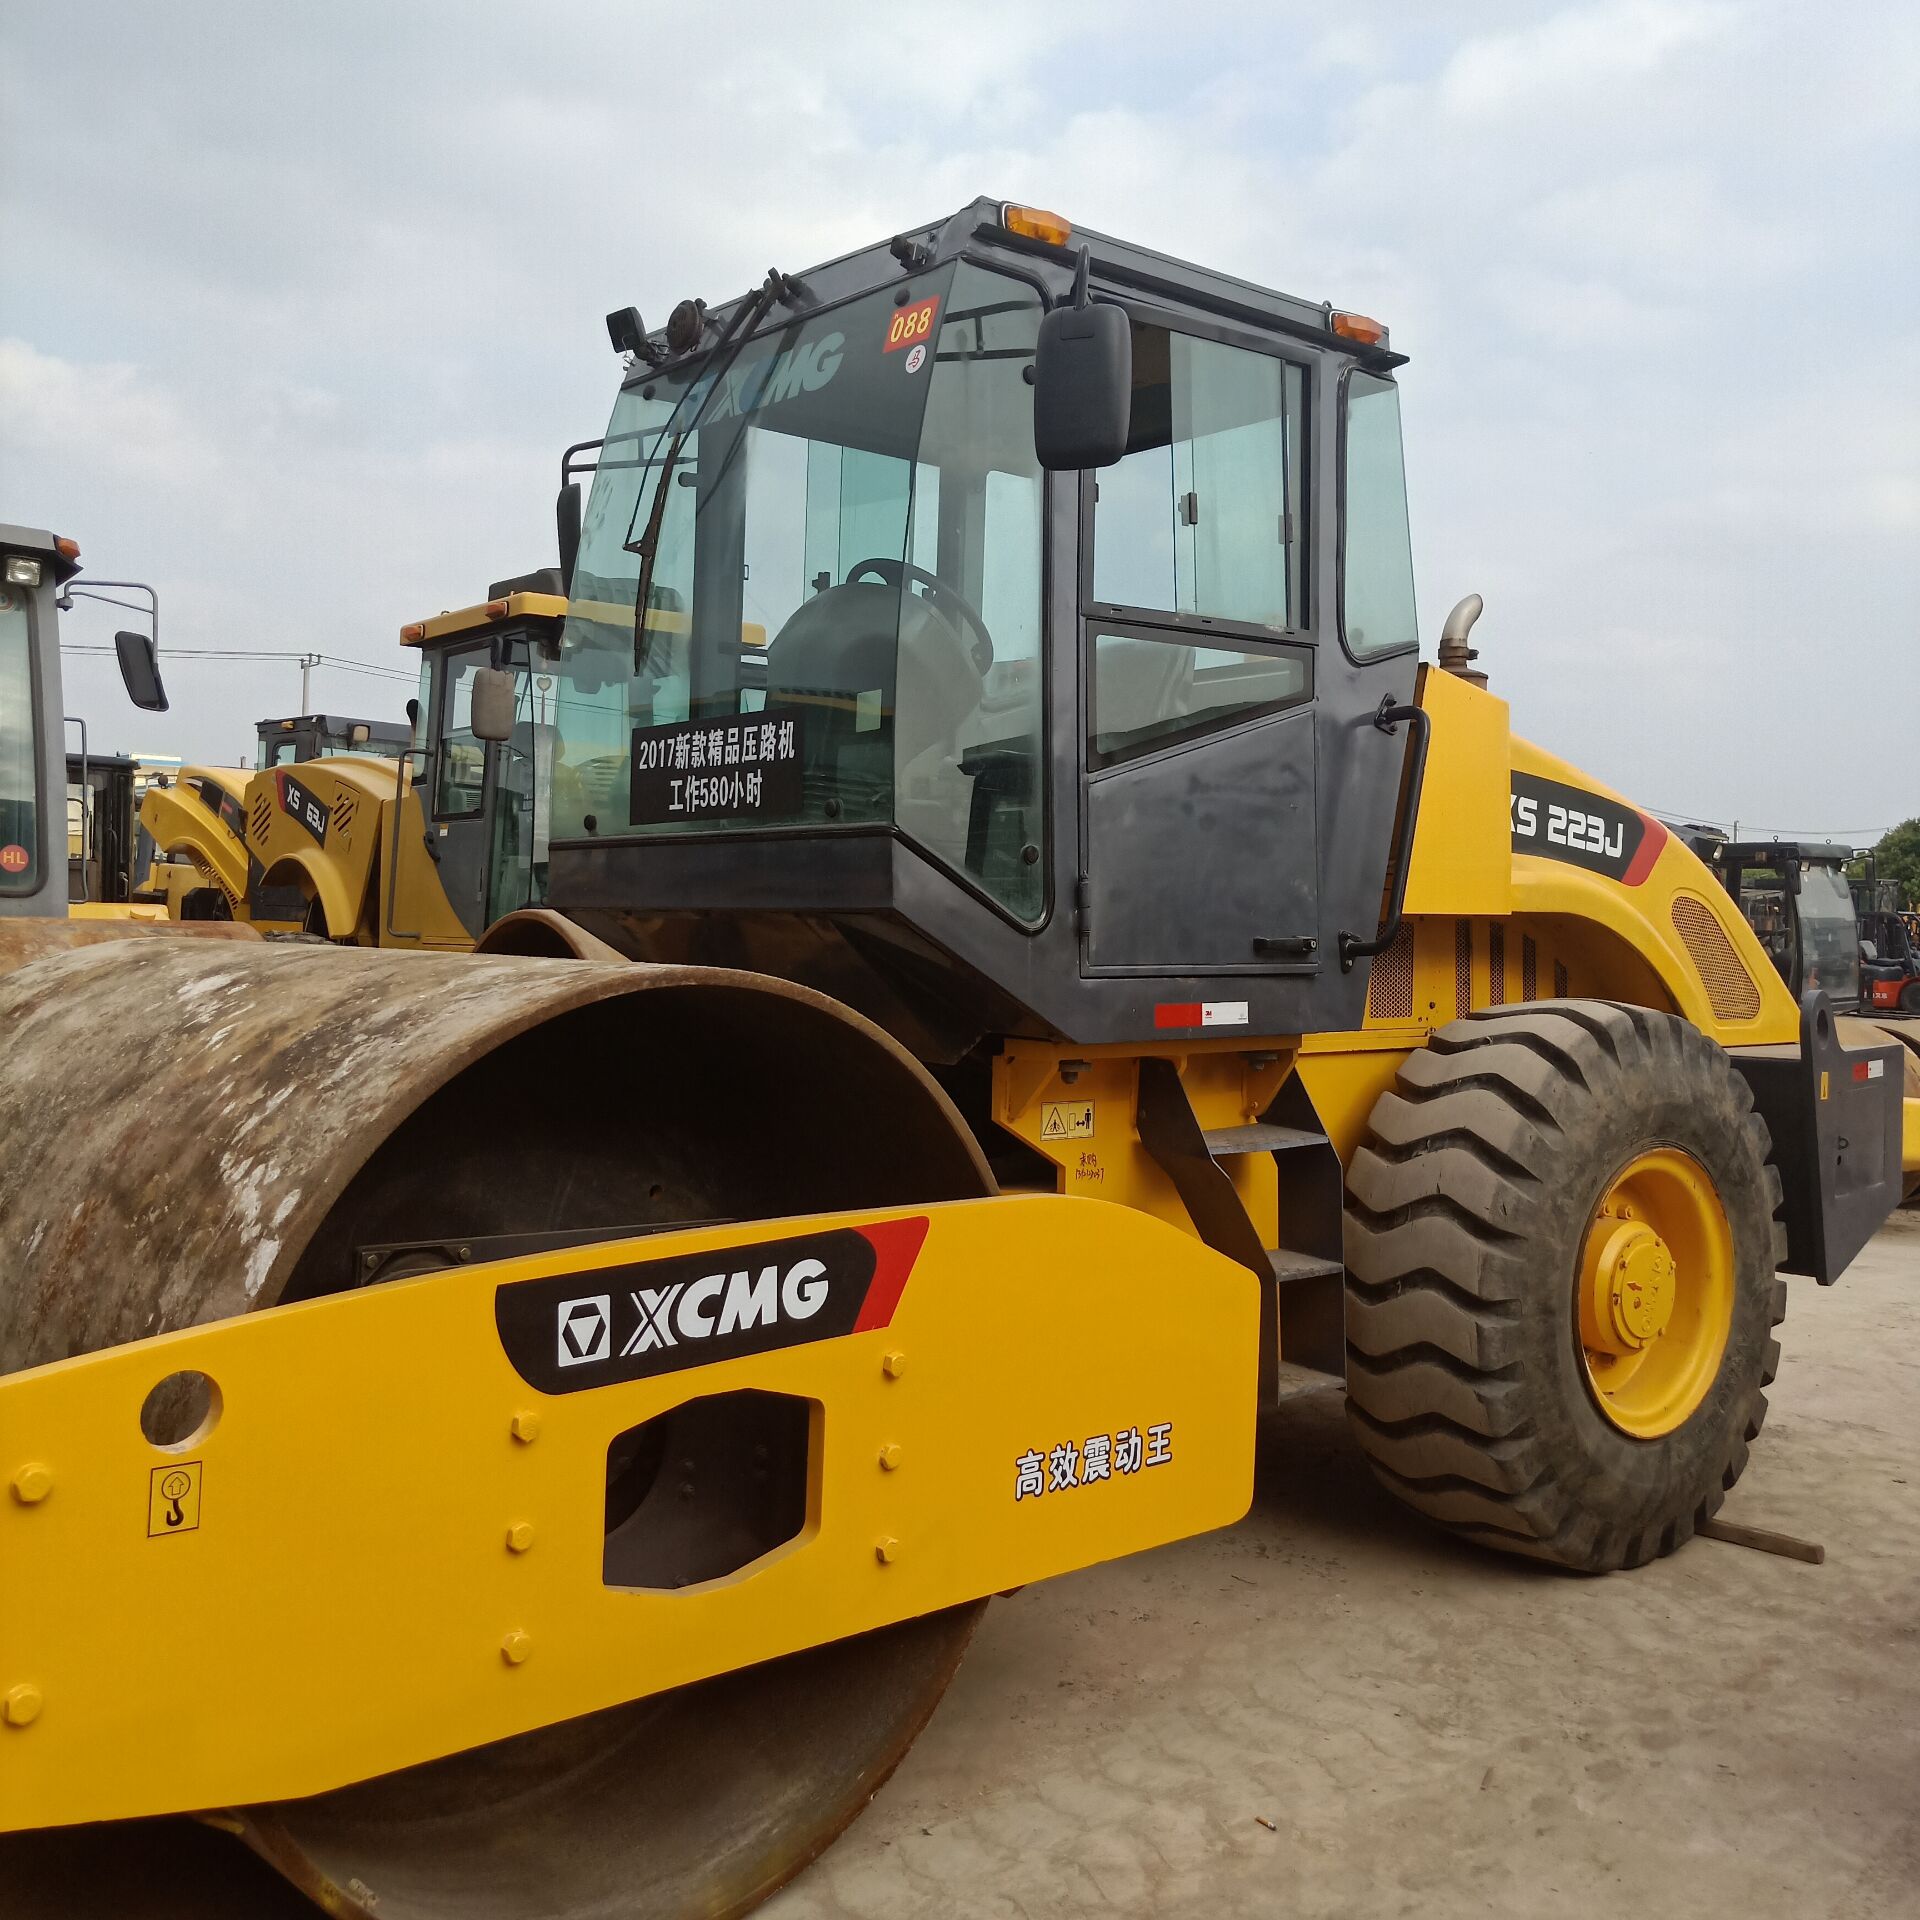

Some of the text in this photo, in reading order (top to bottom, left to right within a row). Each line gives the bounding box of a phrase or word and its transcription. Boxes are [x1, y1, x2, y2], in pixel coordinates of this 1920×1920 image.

[890, 307, 932, 343] 088
[639, 720, 796, 770] 2017新款精品压路机
[287, 784, 326, 834] XS 63J
[668, 768, 763, 813] 工作580小时
[1547, 804, 1624, 858] 223J
[619, 1258, 829, 1357] XCMG
[1014, 1422, 1173, 1501] 高效震动王
